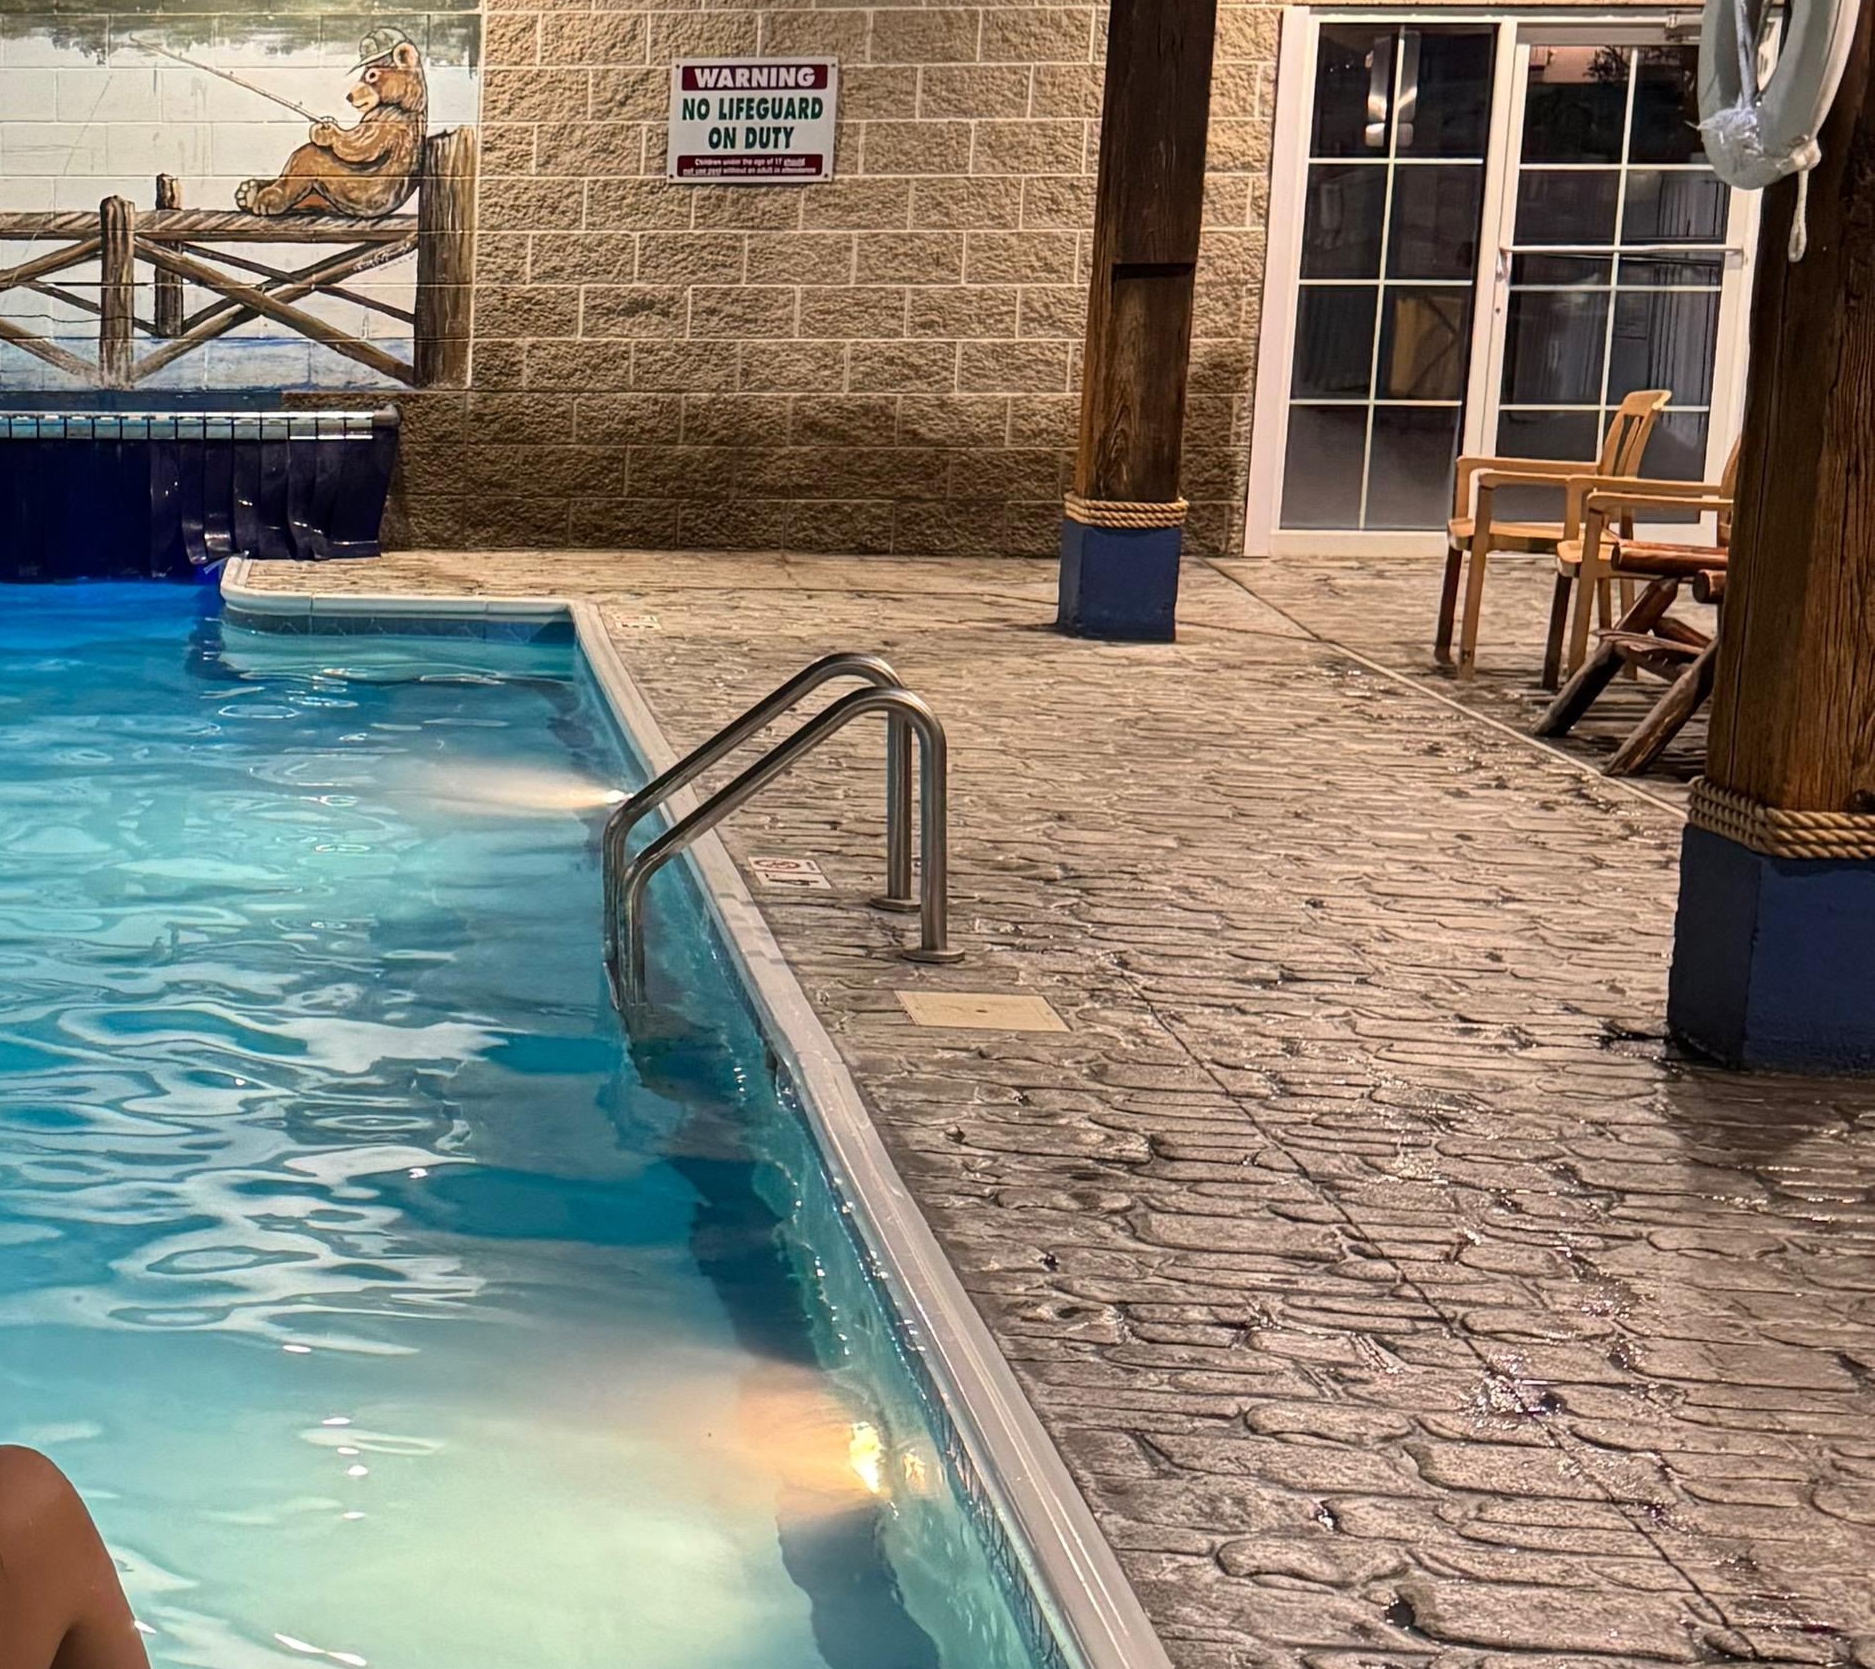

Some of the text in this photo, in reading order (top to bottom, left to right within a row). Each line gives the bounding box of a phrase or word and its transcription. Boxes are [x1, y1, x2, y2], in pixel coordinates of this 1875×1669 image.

[694, 67, 816, 88] WARNING
[682, 97, 823, 120] NO LIFEGUARD
[708, 126, 794, 149] ON DUTY
